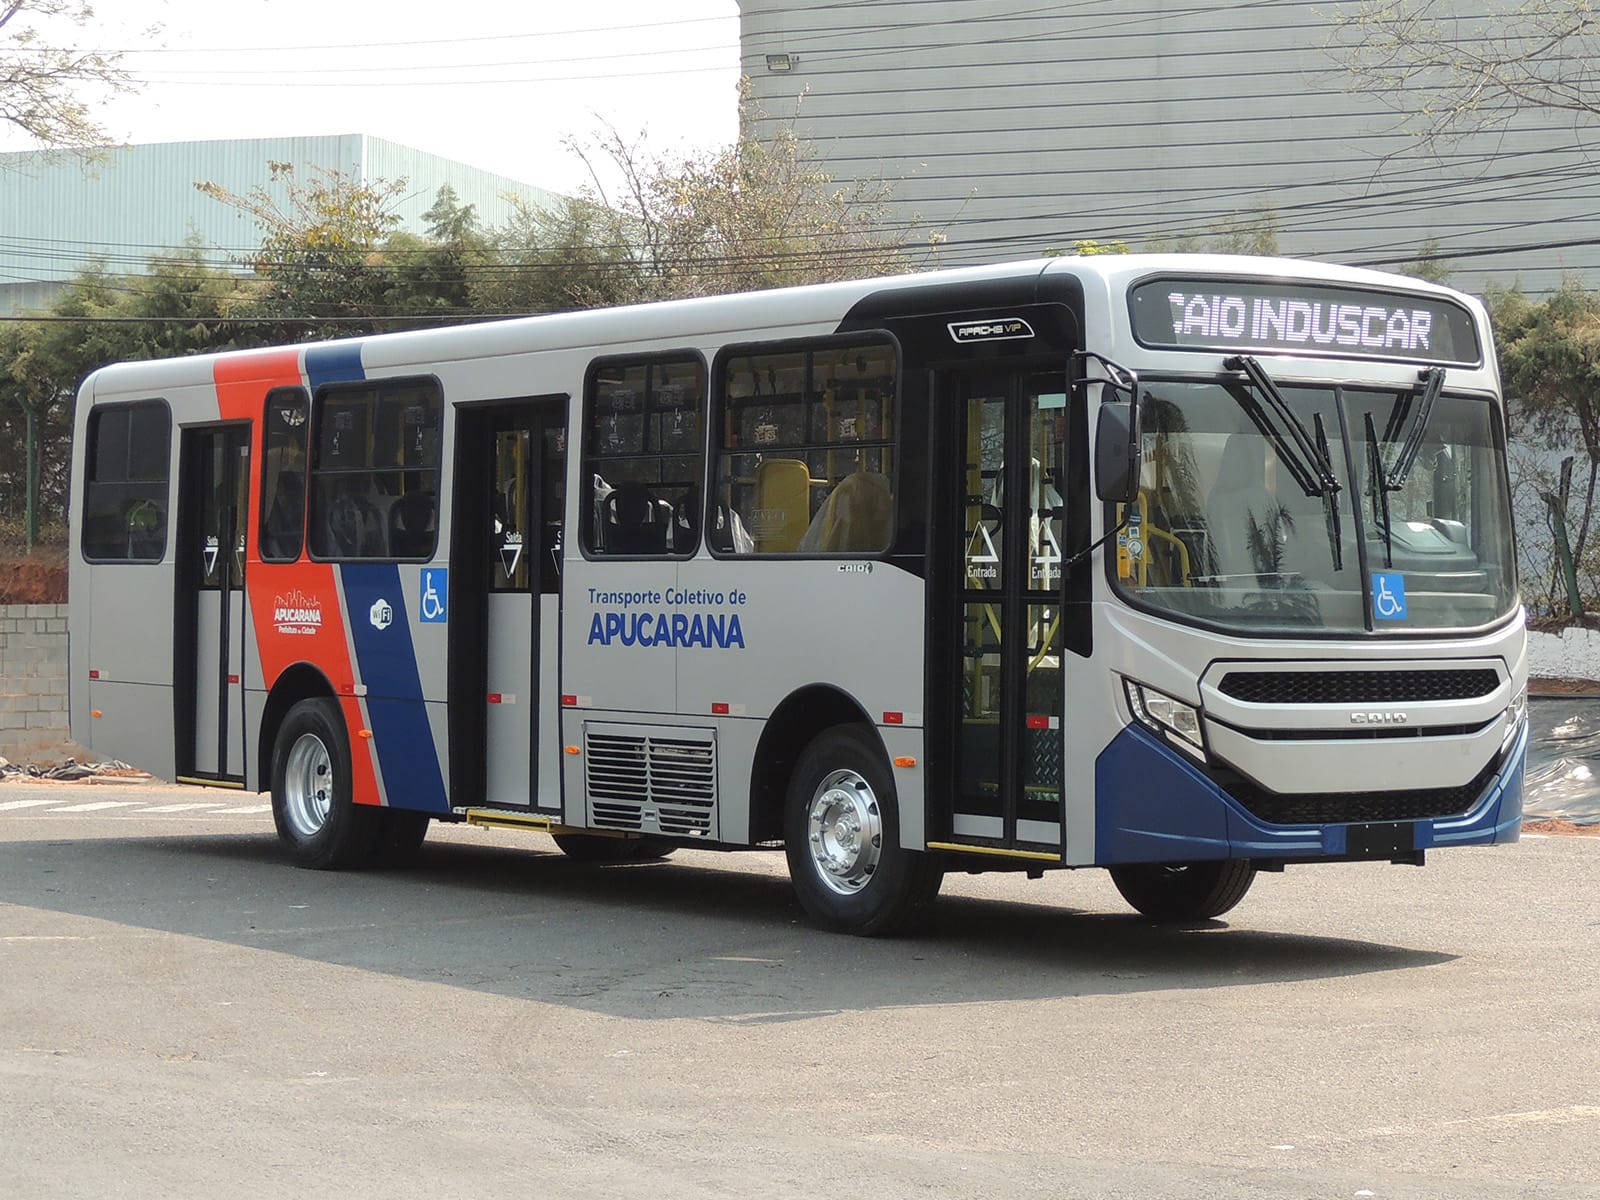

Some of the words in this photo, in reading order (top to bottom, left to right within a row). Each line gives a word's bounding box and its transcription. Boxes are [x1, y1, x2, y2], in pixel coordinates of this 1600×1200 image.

[959, 325, 1003, 336] APACHE
[1004, 323, 1021, 333] VIP
[1251, 298, 1432, 350] INDUSCAR
[967, 565, 997, 578] Entrada
[1031, 566, 1061, 579] Entada
[588, 588, 661, 608] Transporte
[665, 588, 724, 605] Coletivo
[728, 589, 746, 605] de
[274, 608, 321, 622] APUCARANA
[587, 612, 745, 649] APUCARANA
[1350, 712, 1407, 724] CAIO
